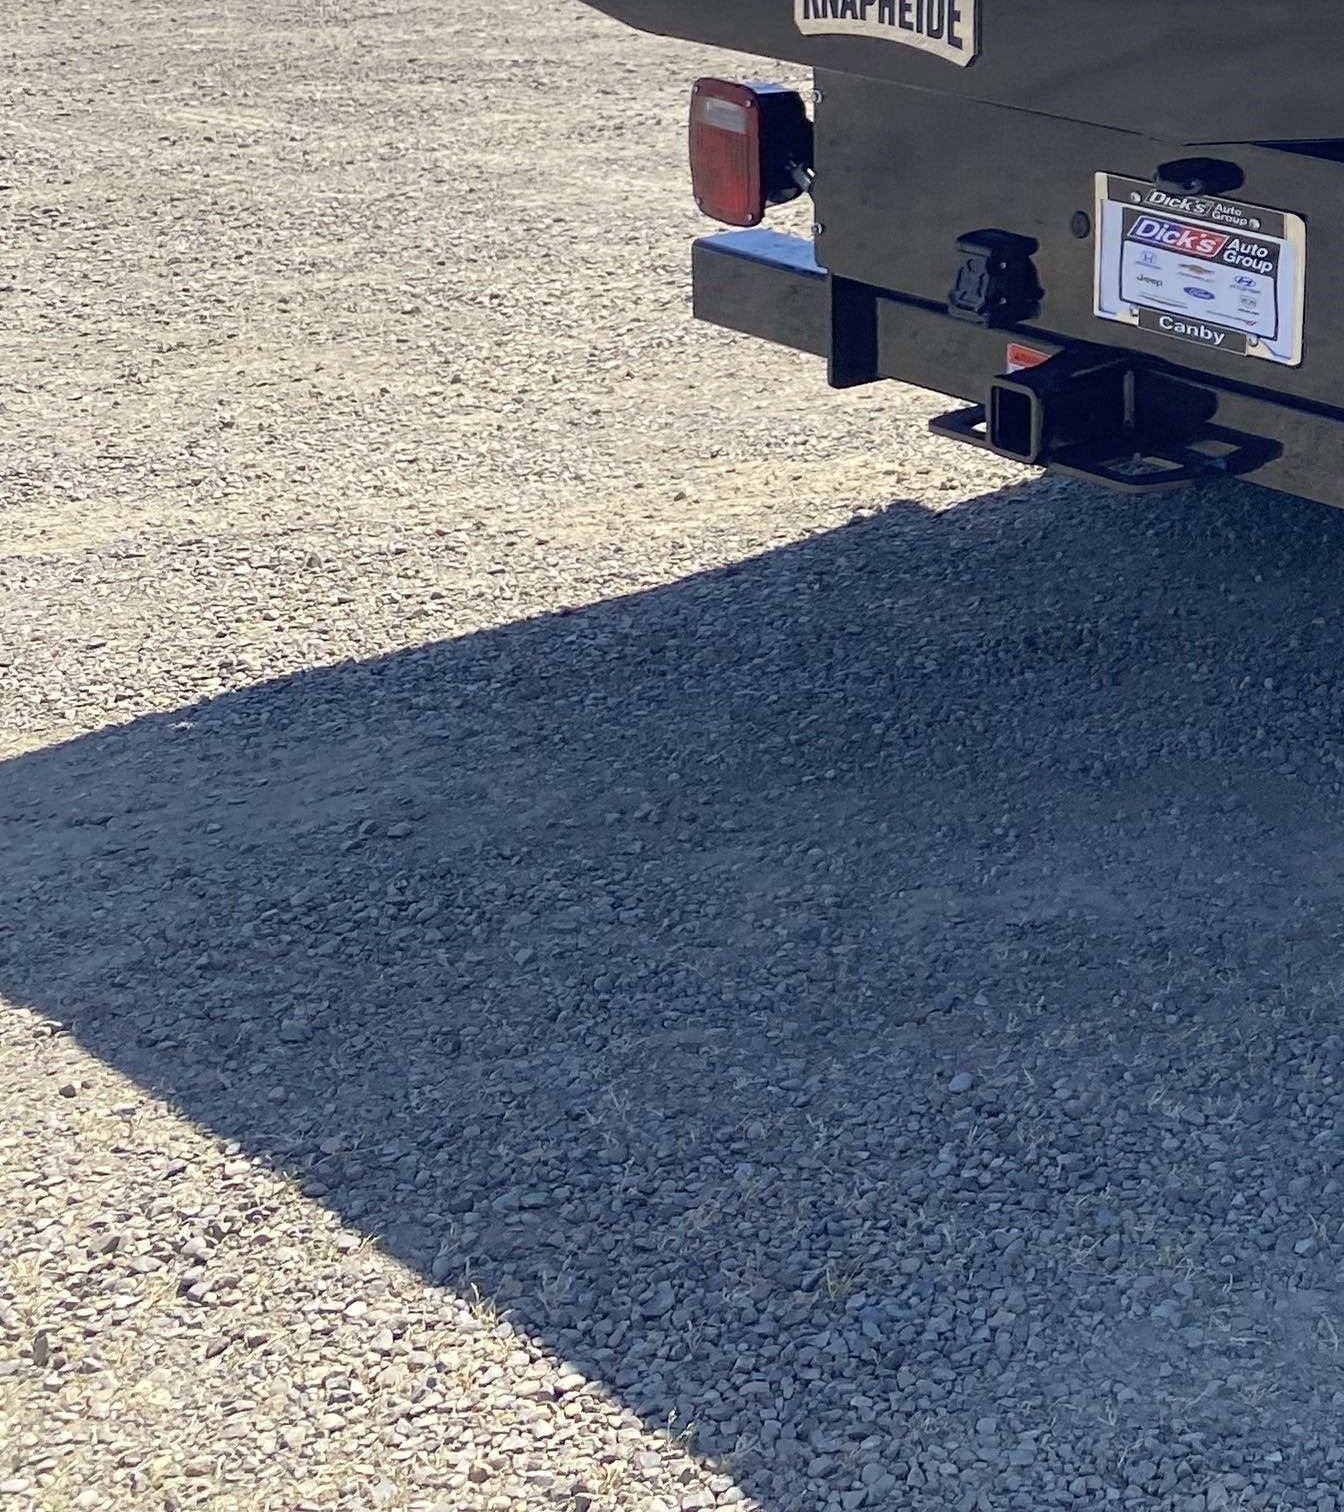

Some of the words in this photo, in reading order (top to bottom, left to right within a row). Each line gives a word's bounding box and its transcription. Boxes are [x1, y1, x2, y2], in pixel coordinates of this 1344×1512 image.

[1149, 191, 1205, 214] Dick's
[1214, 203, 1242, 216] Auto
[1212, 210, 1248, 227] Group
[1135, 219, 1218, 254] Dick's
[1227, 238, 1268, 258] Auto
[1223, 251, 1273, 274] Group
[1159, 315, 1225, 346] Canby
